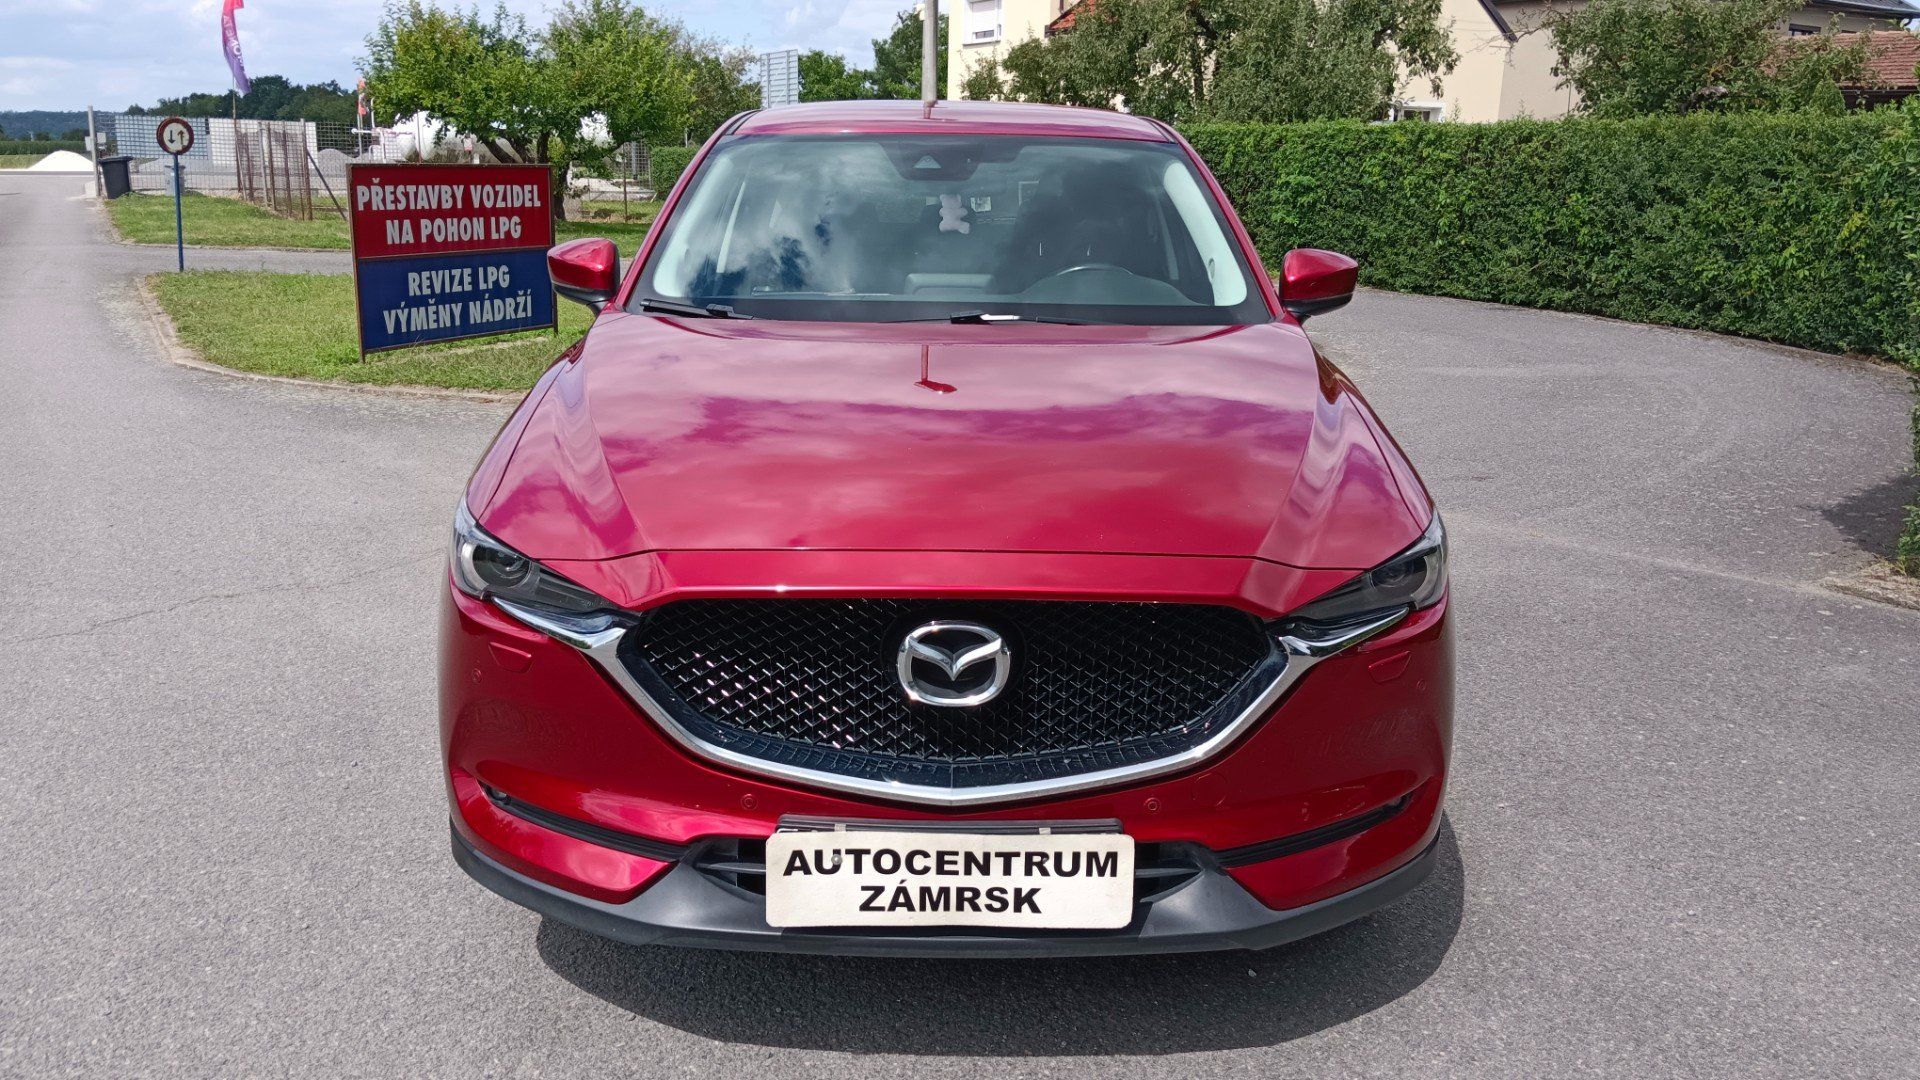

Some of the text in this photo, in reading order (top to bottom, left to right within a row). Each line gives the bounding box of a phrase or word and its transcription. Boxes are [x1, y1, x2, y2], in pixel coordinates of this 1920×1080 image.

[356, 177, 541, 211] PŘESTAVBY VOZIDEL
[386, 215, 522, 245] NA POHON LPG
[407, 265, 510, 297] REVIZE LPG
[383, 288, 533, 335] VÝMĚNY NÁDRŽÍ
[783, 848, 1118, 878] AUTOCENTRUM
[859, 880, 1042, 914] ZÁMRSK
